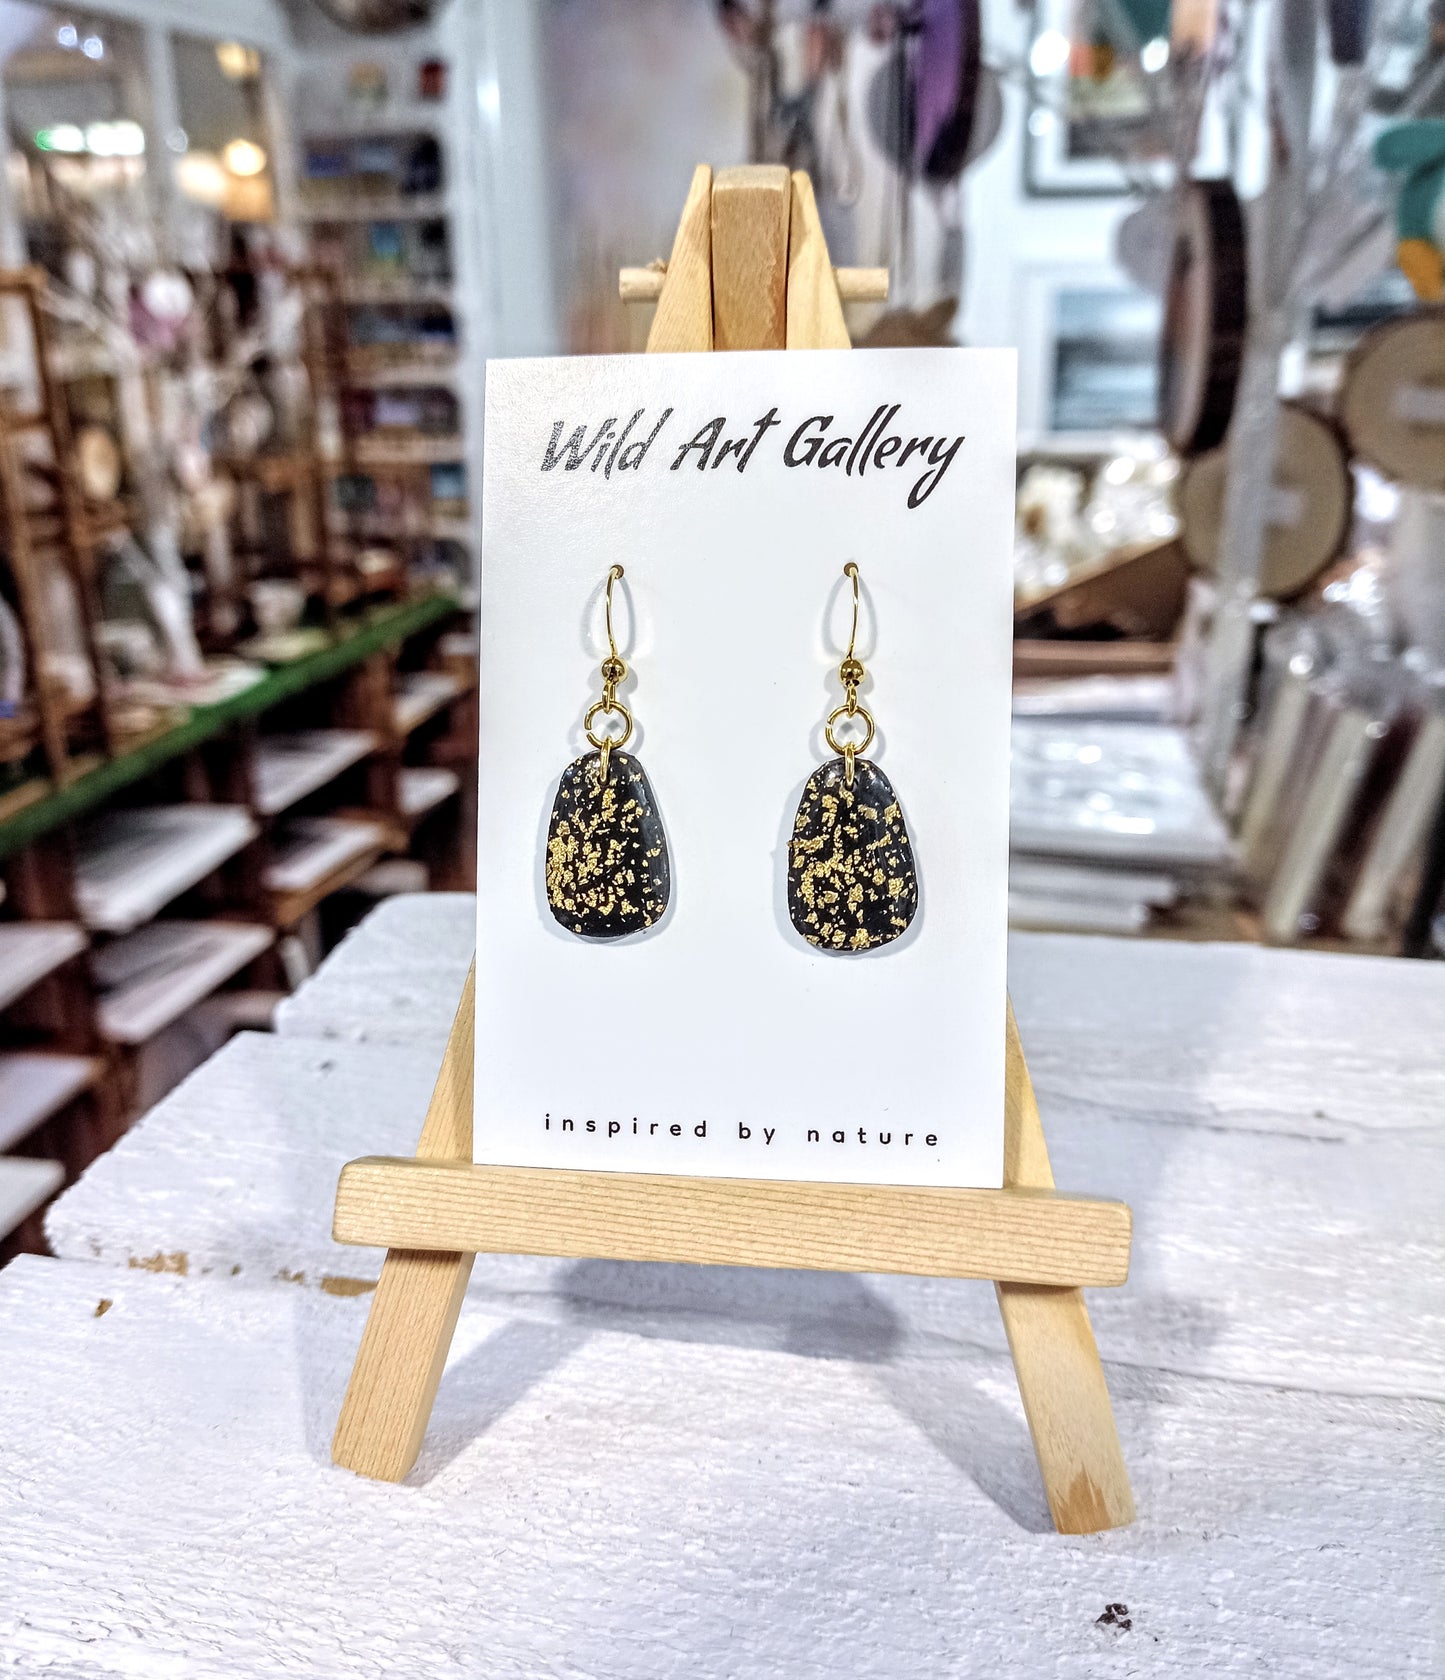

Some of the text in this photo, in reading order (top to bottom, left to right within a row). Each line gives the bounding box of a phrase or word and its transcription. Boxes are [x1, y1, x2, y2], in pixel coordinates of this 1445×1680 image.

[540, 403, 966, 509] Wild Art Gallery
[544, 1112, 939, 1148] inspired by nature
